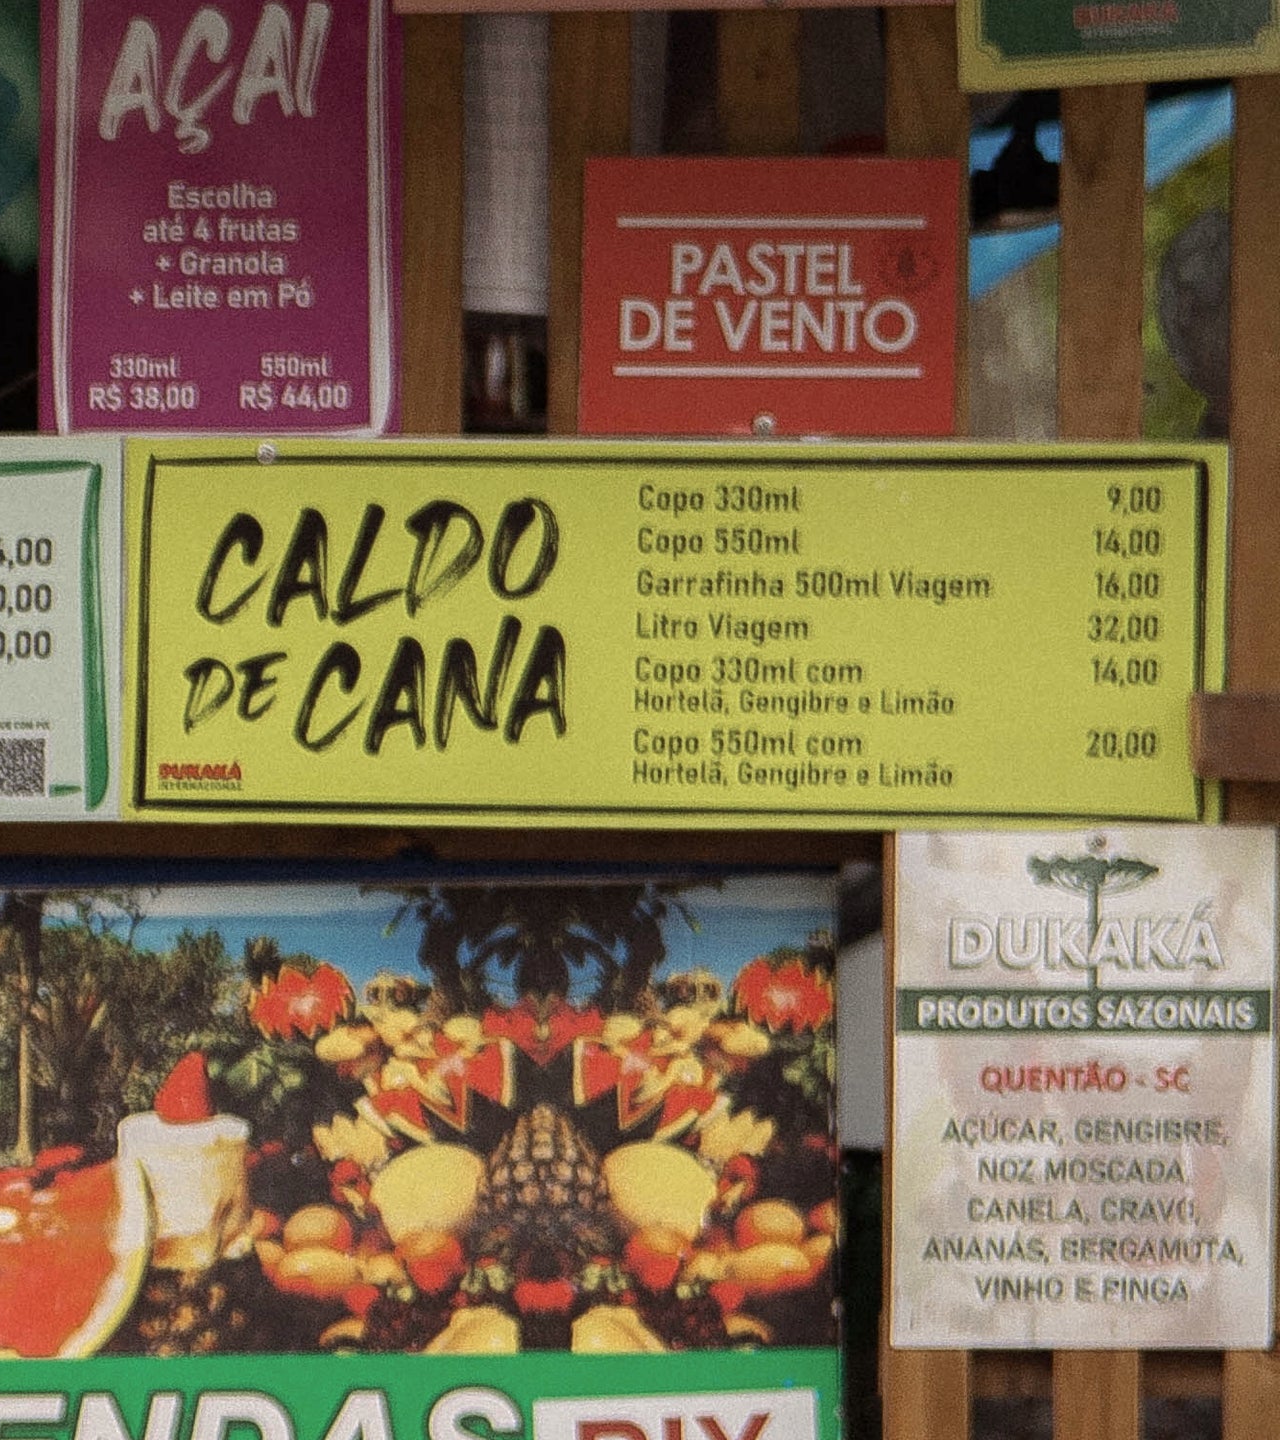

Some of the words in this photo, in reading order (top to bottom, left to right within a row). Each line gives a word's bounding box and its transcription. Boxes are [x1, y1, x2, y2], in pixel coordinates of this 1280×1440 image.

[168, 182, 274, 210] Escolha
[142, 213, 185, 243] até
[193, 216, 211, 242] 4
[218, 216, 298, 242] frutas
[672, 243, 863, 296] PASTEL
[619, 299, 694, 351] DE
[715, 299, 918, 353] VENTO
[638, 484, 705, 518] Copo
[715, 484, 799, 512] 330ml
[1107, 485, 1162, 513] 9,00
[194, 496, 561, 628] CALDO
[637, 569, 784, 597] Garrafinha
[796, 570, 880, 598] 500ml
[889, 571, 991, 606] Viagem
[1096, 571, 1160, 600] 16,00
[182, 650, 288, 735] DE
[293, 614, 568, 757] CANA
[634, 688, 729, 715] Hortelã,
[739, 689, 849, 718] Gengibre
[858, 696, 871, 714] e
[881, 690, 955, 715] Limão
[947, 896, 1226, 973] DUKAKÁ
[918, 998, 1090, 1030] PRODUTOS
[1097, 998, 1256, 1029] SAZONAIS
[980, 1060, 1127, 1095] QUENTÃO
[1155, 1066, 1191, 1093] SC
[942, 1113, 1064, 1147] AÇÚCAR,
[1074, 1118, 1231, 1148] GENGIBRE,
[967, 1197, 1090, 1226] CANELA,
[1100, 1197, 1201, 1226] CRAVO,
[922, 1235, 1050, 1265] ANANÁS,
[1060, 1237, 1244, 1265] BERGAMOTA,
